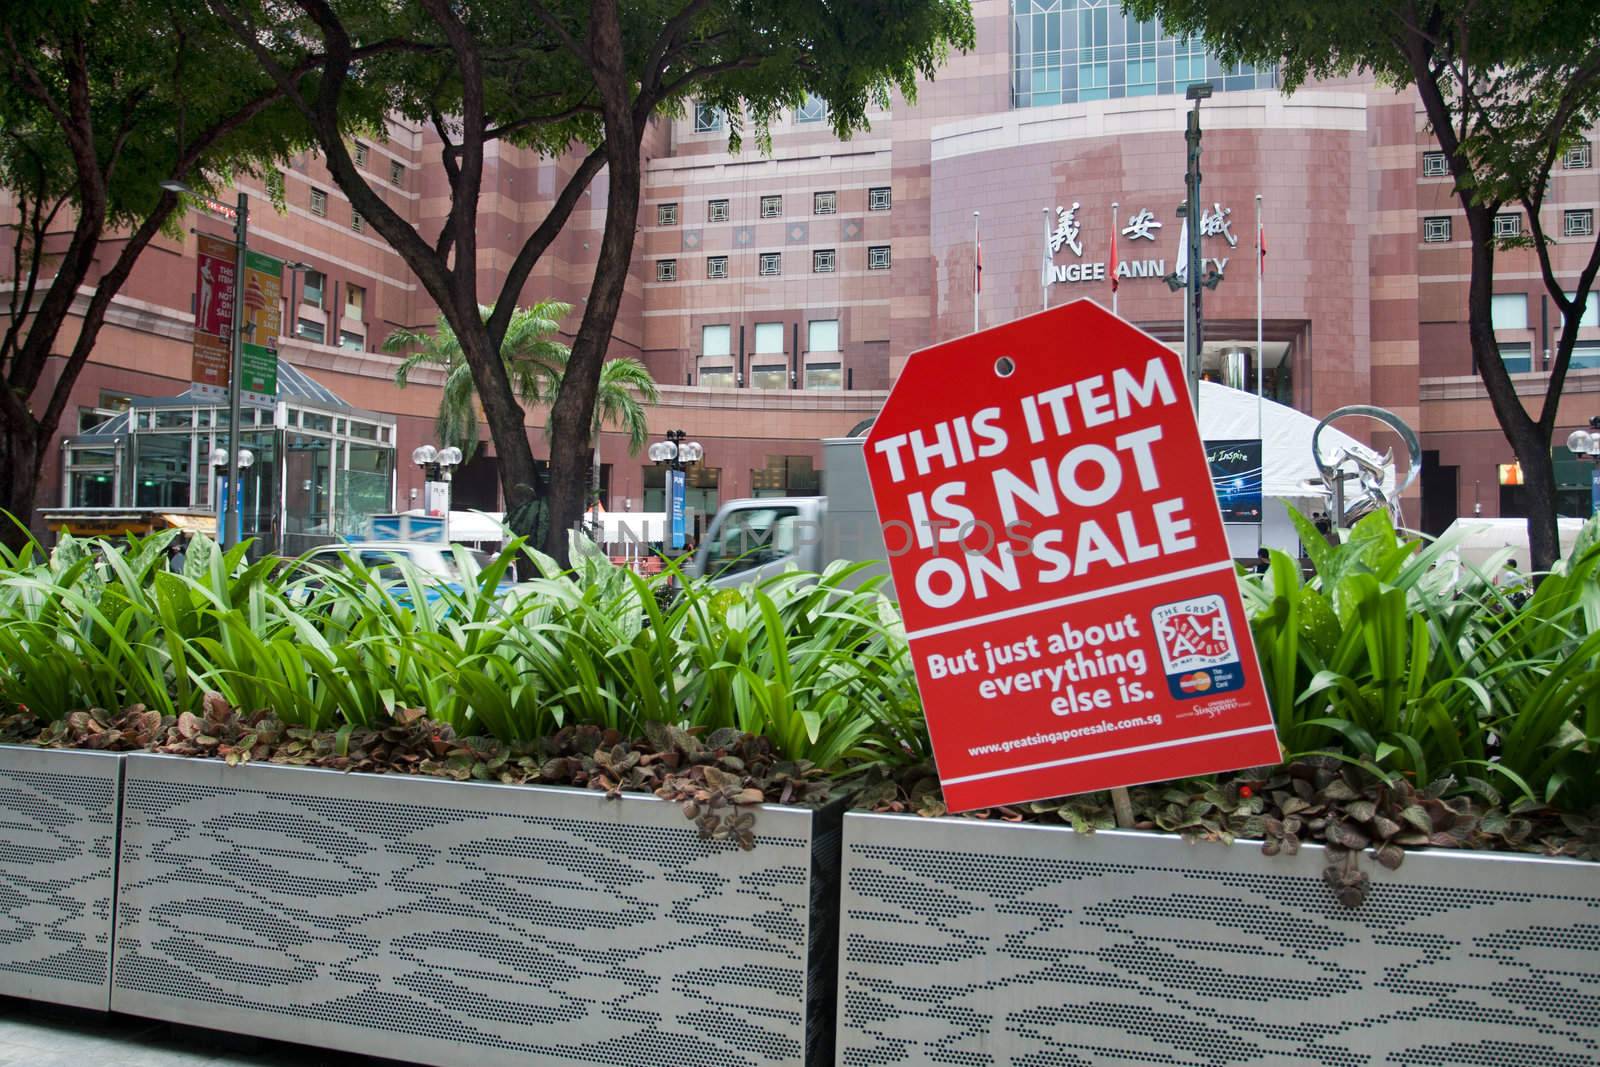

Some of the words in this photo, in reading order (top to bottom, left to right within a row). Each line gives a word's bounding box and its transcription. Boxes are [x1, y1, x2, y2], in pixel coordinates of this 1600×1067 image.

[1053, 262, 1105, 283] NGEE
[1116, 259, 1165, 279] ANN
[874, 407, 1008, 483] THIS
[1020, 357, 1177, 444] ITEM
[1218, 449, 1248, 463] Inspire
[907, 481, 975, 549] IS
[991, 425, 1164, 532] NOT
[915, 541, 1022, 608] ON
[1031, 497, 1197, 584] SALE
[1158, 606, 1178, 619] THE
[1184, 600, 1218, 614] GREAT
[926, 648, 979, 680] But
[982, 634, 1041, 674] just
[1047, 613, 1140, 655] about
[1159, 613, 1227, 658] SALE
[978, 648, 1147, 699] everything
[1051, 684, 1112, 717] else
[1116, 677, 1154, 704] is.
[967, 713, 1163, 757] www.greatsingaporesale.com.sg
